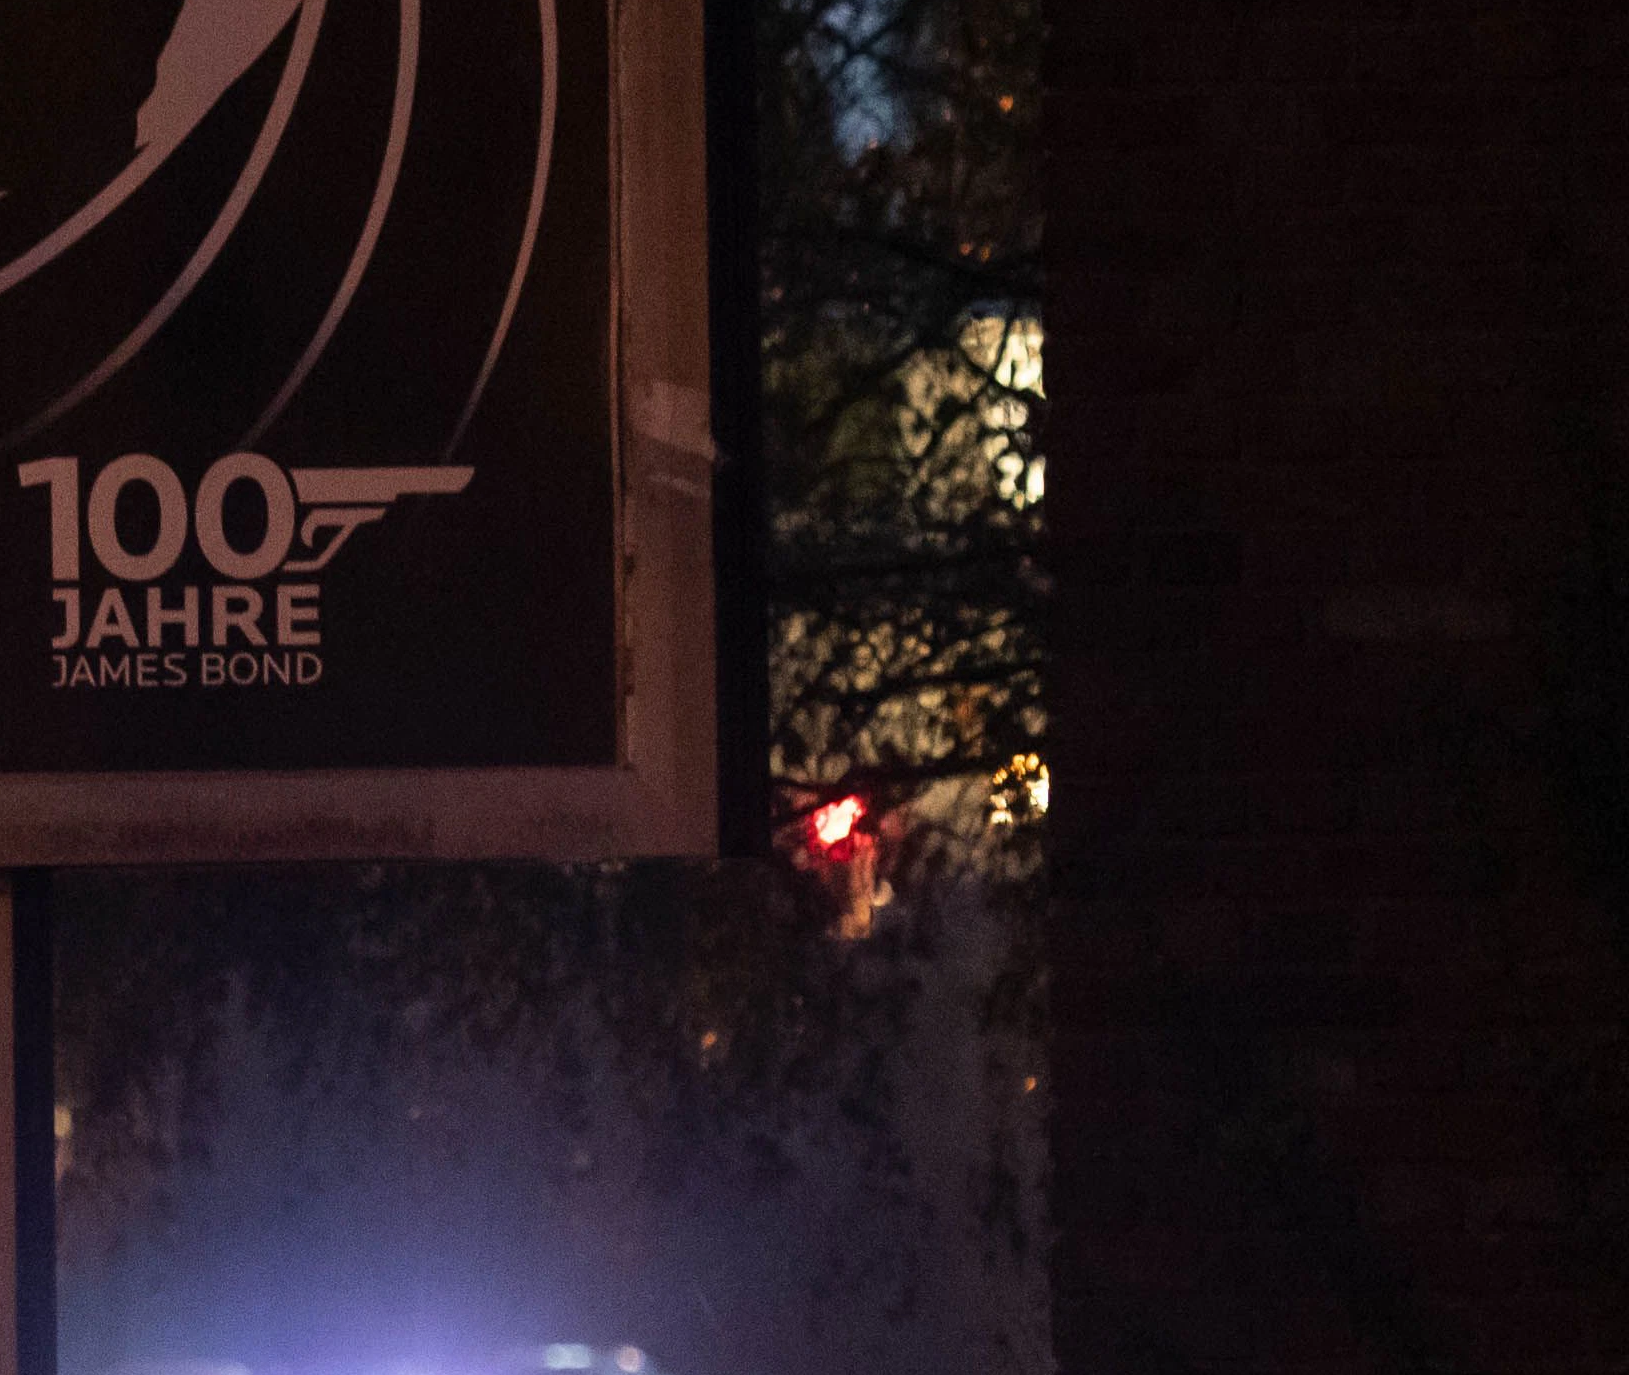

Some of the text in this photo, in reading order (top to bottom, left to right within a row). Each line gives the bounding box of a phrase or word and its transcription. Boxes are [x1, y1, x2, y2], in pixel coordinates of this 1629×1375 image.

[17, 452, 296, 581] 100
[51, 584, 321, 649] JAHRE
[53, 651, 323, 687] JAMES BOND
